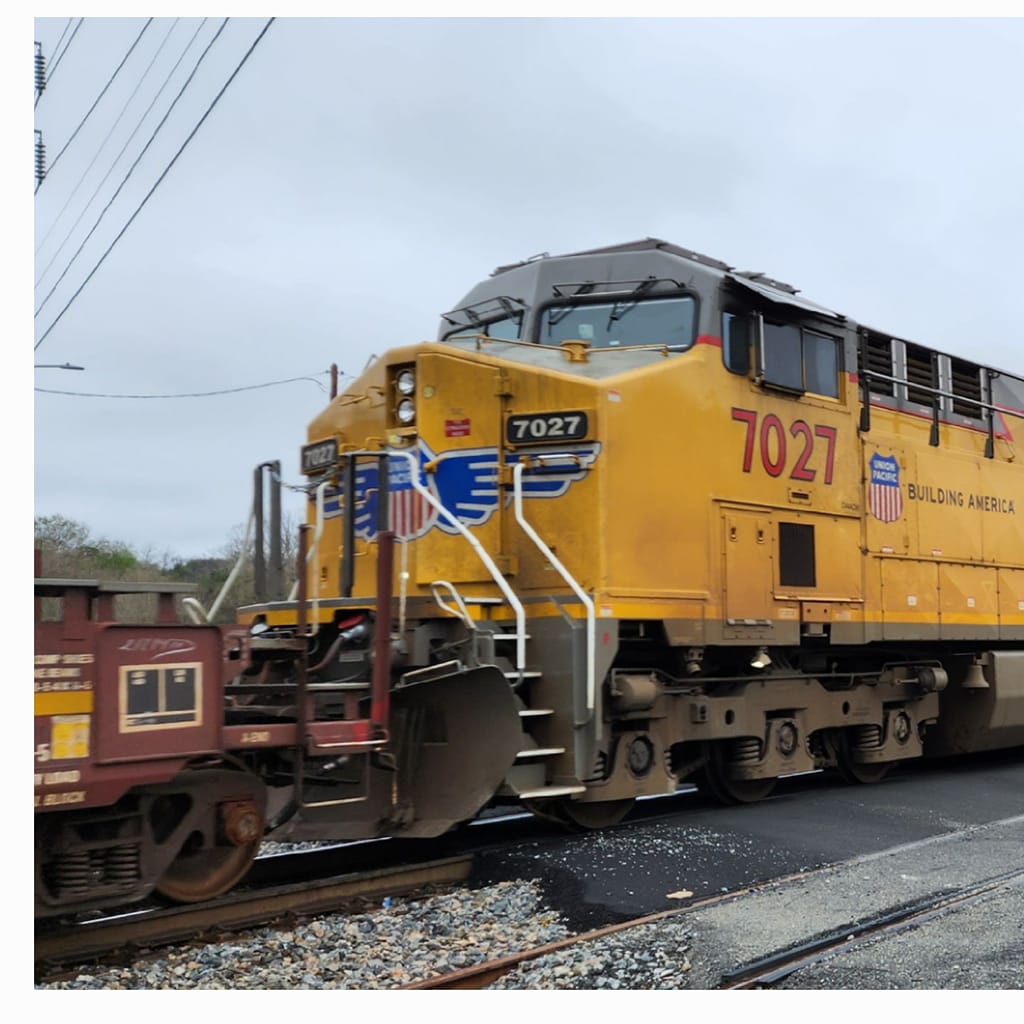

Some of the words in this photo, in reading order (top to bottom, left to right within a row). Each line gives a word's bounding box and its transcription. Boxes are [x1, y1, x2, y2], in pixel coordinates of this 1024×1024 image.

[512, 416, 580, 438] 7027
[304, 444, 336, 467] 7027
[731, 407, 837, 485] 7027
[873, 460, 896, 472] UNION
[873, 470, 897, 482] PACIFIC
[908, 483, 964, 507] BUILDING
[968, 494, 1016, 515] AMERICA
